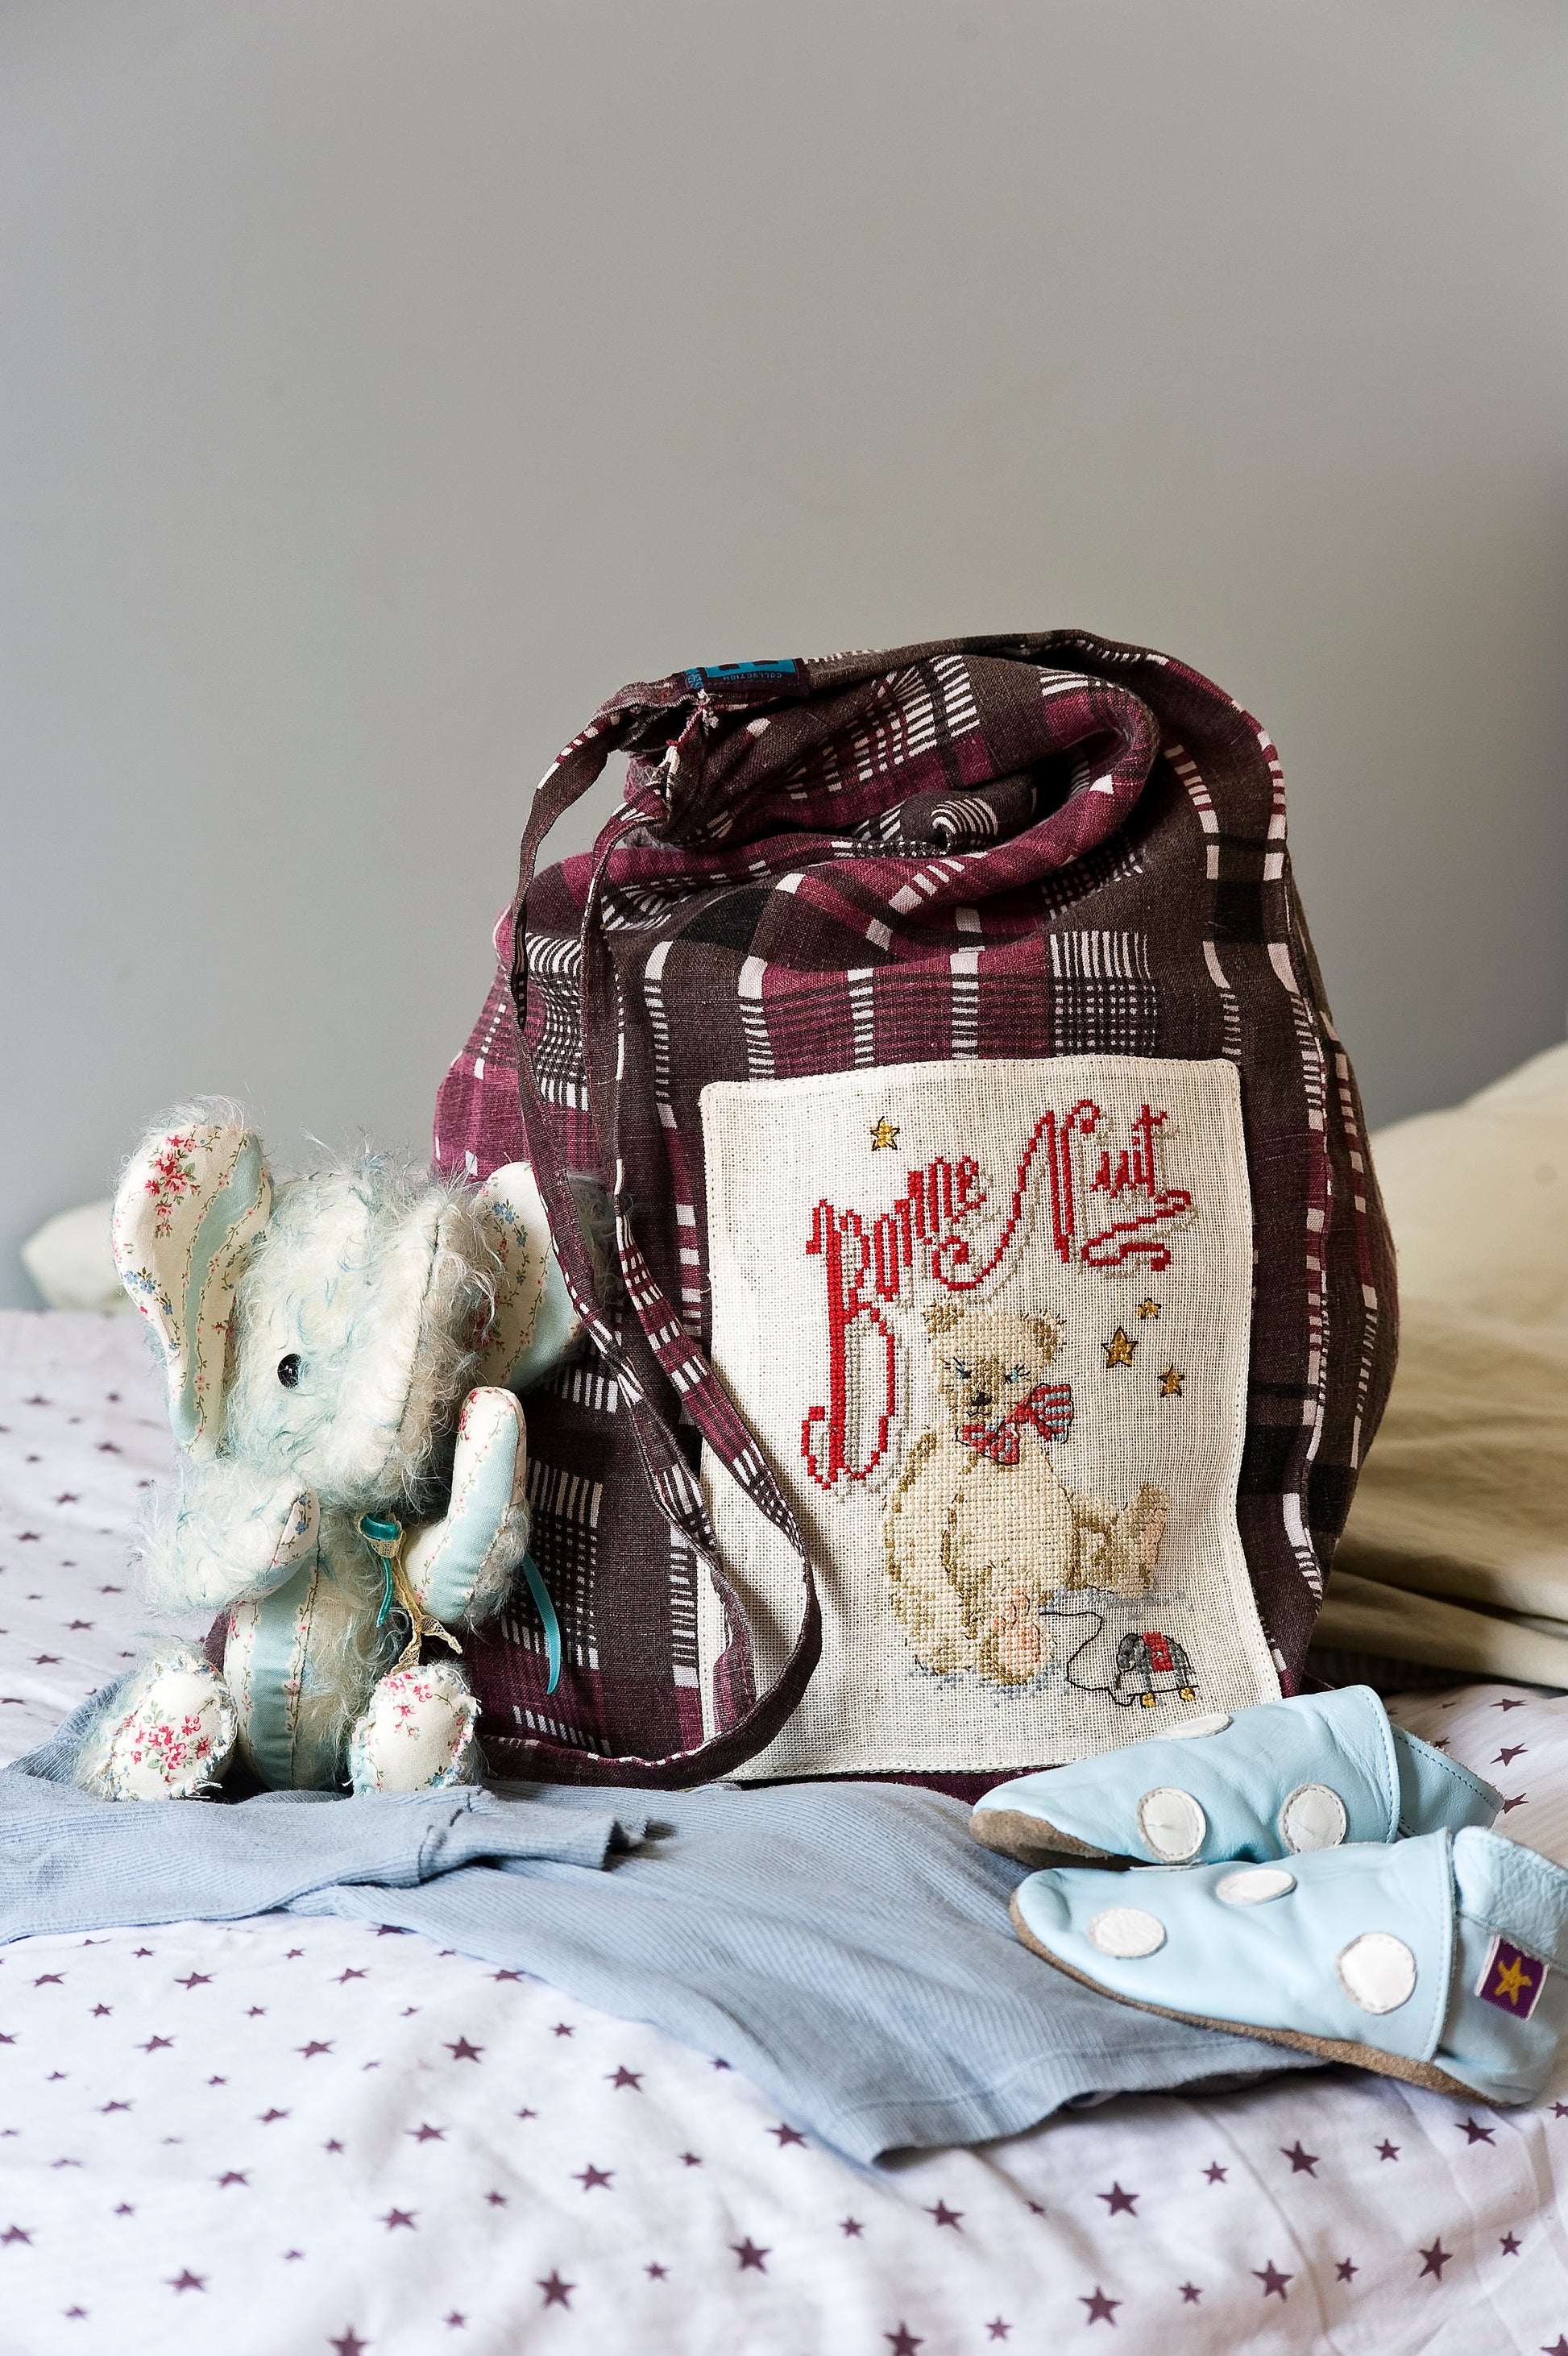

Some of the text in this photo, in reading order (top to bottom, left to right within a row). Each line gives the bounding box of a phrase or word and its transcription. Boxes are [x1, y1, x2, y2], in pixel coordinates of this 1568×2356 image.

[723, 672, 782, 682] COLLECTION
[802, 1099, 1193, 1490] Bonne Nuit
